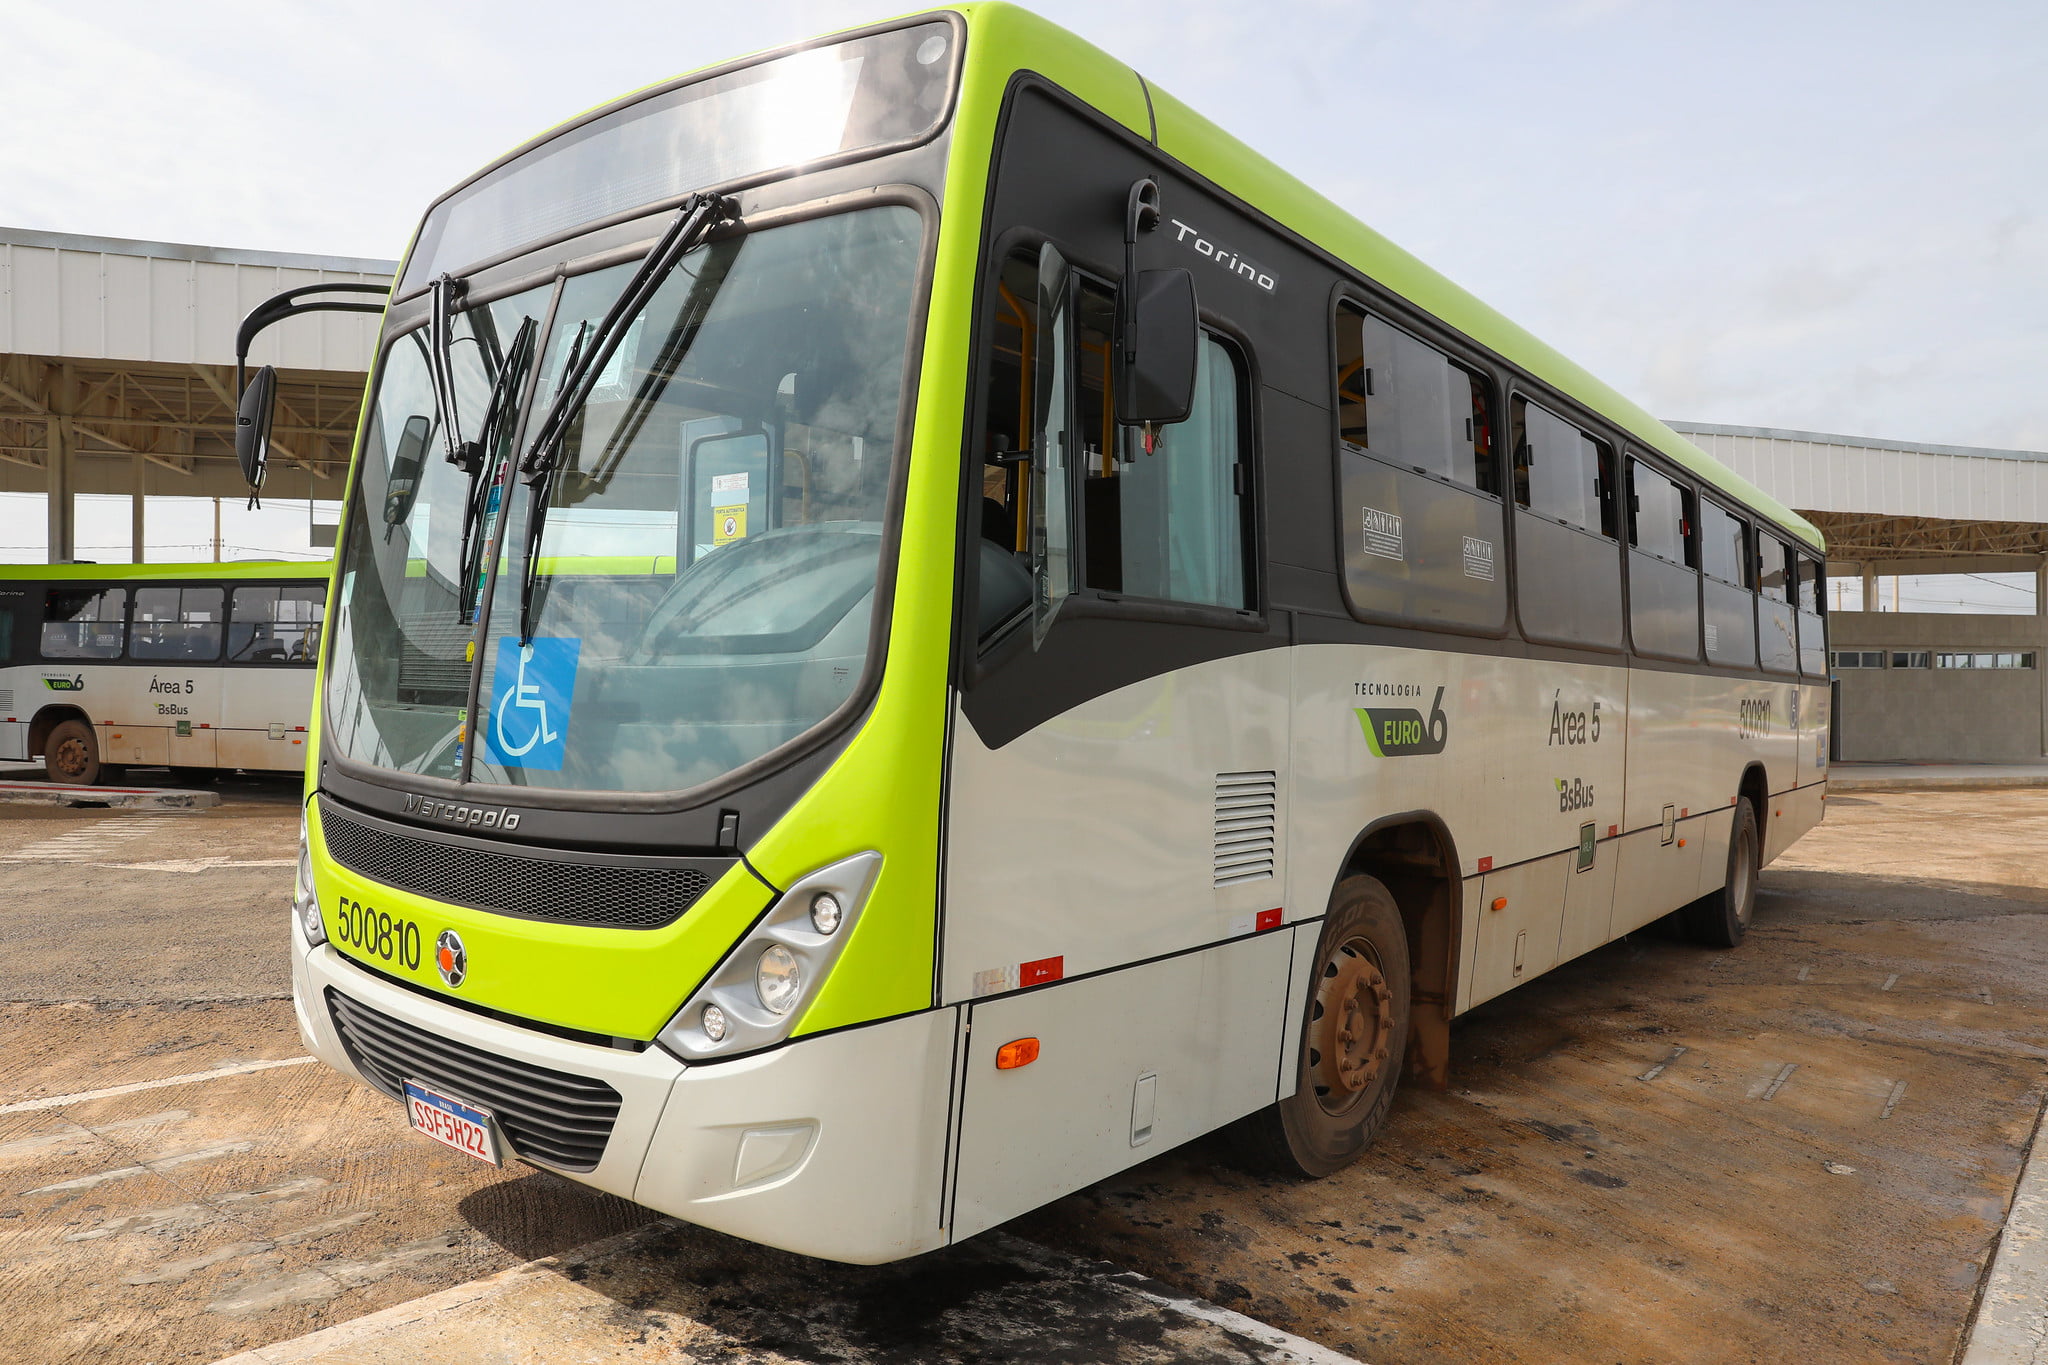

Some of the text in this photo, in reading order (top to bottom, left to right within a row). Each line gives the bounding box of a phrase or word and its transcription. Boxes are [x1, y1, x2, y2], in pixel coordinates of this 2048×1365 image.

[1171, 218, 1275, 291] Torino
[74, 674, 84, 691] 6
[149, 675, 194, 694] Área 5
[1354, 682, 1422, 697] TECNOLOGIA
[158, 703, 189, 716] BsBus
[1428, 686, 1448, 750] 6
[1548, 688, 1601, 747] Área 5
[1740, 698, 1771, 740] 500810
[1383, 719, 1422, 746] EURO
[401, 793, 521, 831] Marcopolo
[1558, 777, 1595, 813] BsBus
[338, 896, 422, 971] 500810
[414, 1101, 487, 1156] SSF5H22
